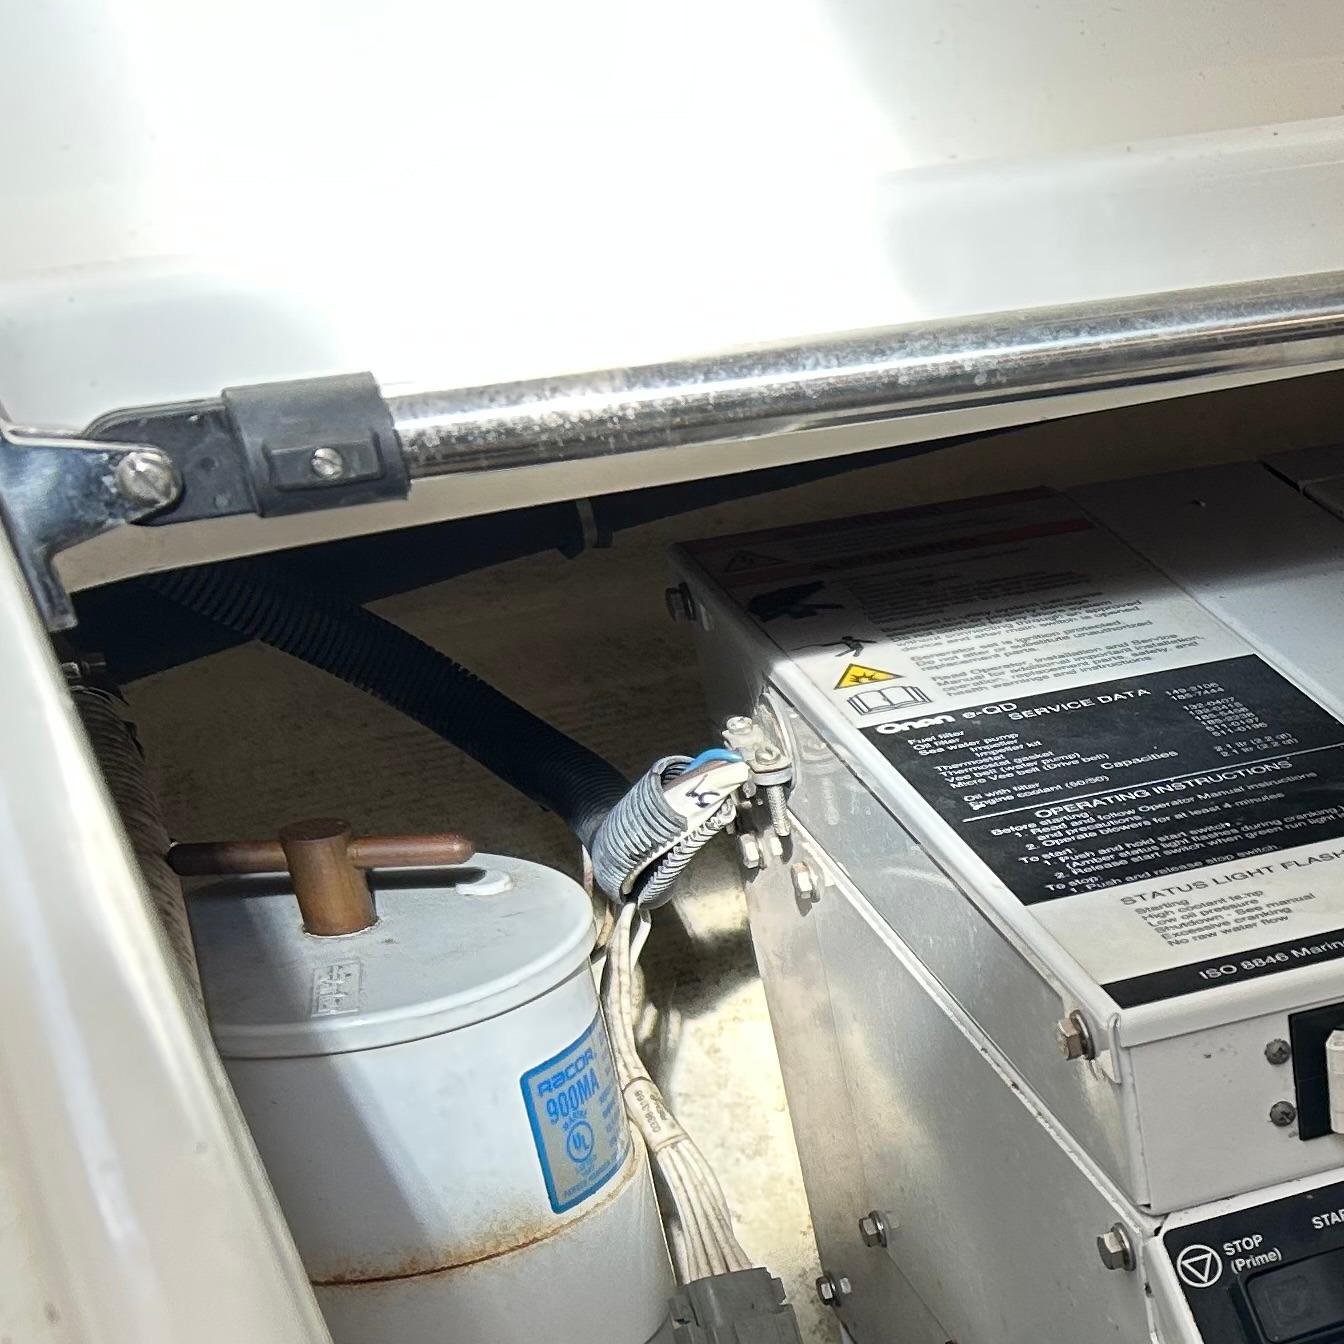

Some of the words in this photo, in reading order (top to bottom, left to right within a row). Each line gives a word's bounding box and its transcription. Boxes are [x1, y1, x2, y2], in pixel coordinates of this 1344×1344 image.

[1008, 698, 1094, 719] SERVICE
[1097, 689, 1150, 703] DATA
[876, 715, 954, 733] Onan
[912, 742, 931, 750] Oil
[933, 738, 959, 746] filter
[918, 747, 944, 755] Sea
[946, 740, 979, 750] water
[983, 733, 1018, 743] pump
[969, 739, 1017, 751] Impeller
[974, 744, 1023, 757] Impeller
[934, 754, 1005, 771] Thermostat
[940, 759, 1010, 776] Thermostat
[1013, 751, 1054, 763] gasket
[1100, 751, 1177, 769] Capacities
[963, 793, 982, 801] Oil
[984, 788, 1010, 796] with
[1012, 782, 1039, 791] filter
[1035, 789, 1150, 817] OPERATING
[1152, 761, 1291, 793] INSTRUCTIONS
[1030, 822, 1067, 834] Read
[1070, 816, 1095, 826] and
[1097, 809, 1135, 820] follow
[1138, 797, 1193, 811] Operator
[1196, 786, 1244, 799] Manual
[1246, 772, 1316, 789] instructions
[1066, 854, 1114, 869] (Amber
[1118, 845, 1159, 857] status
[1159, 838, 1189, 848] light
[1190, 828, 1238, 841] flashes
[1240, 819, 1282, 831] during
[1120, 881, 1208, 904] STATUS
[1212, 865, 1273, 884] LIGHT
[1134, 899, 1189, 914] Starting
[1141, 910, 1174, 920] High
[1177, 897, 1227, 912] coolant
[1147, 917, 1176, 927] Low
[1180, 911, 1197, 919] oil
[1199, 899, 1258, 916] pressure
[1161, 920, 1230, 939] Excessive
[1234, 907, 1292, 923] cranking
[1166, 938, 1189, 946] No
[1191, 931, 1217, 940] raw
[1220, 922, 1257, 934] water
[1260, 915, 1288, 924] flow
[1199, 964, 1237, 978] ISO
[1240, 952, 1288, 969] 8846
[546, 1068, 600, 1125] 900MA
[1223, 1234, 1262, 1255] STOP
[1231, 1247, 1281, 1273] (Prime)
